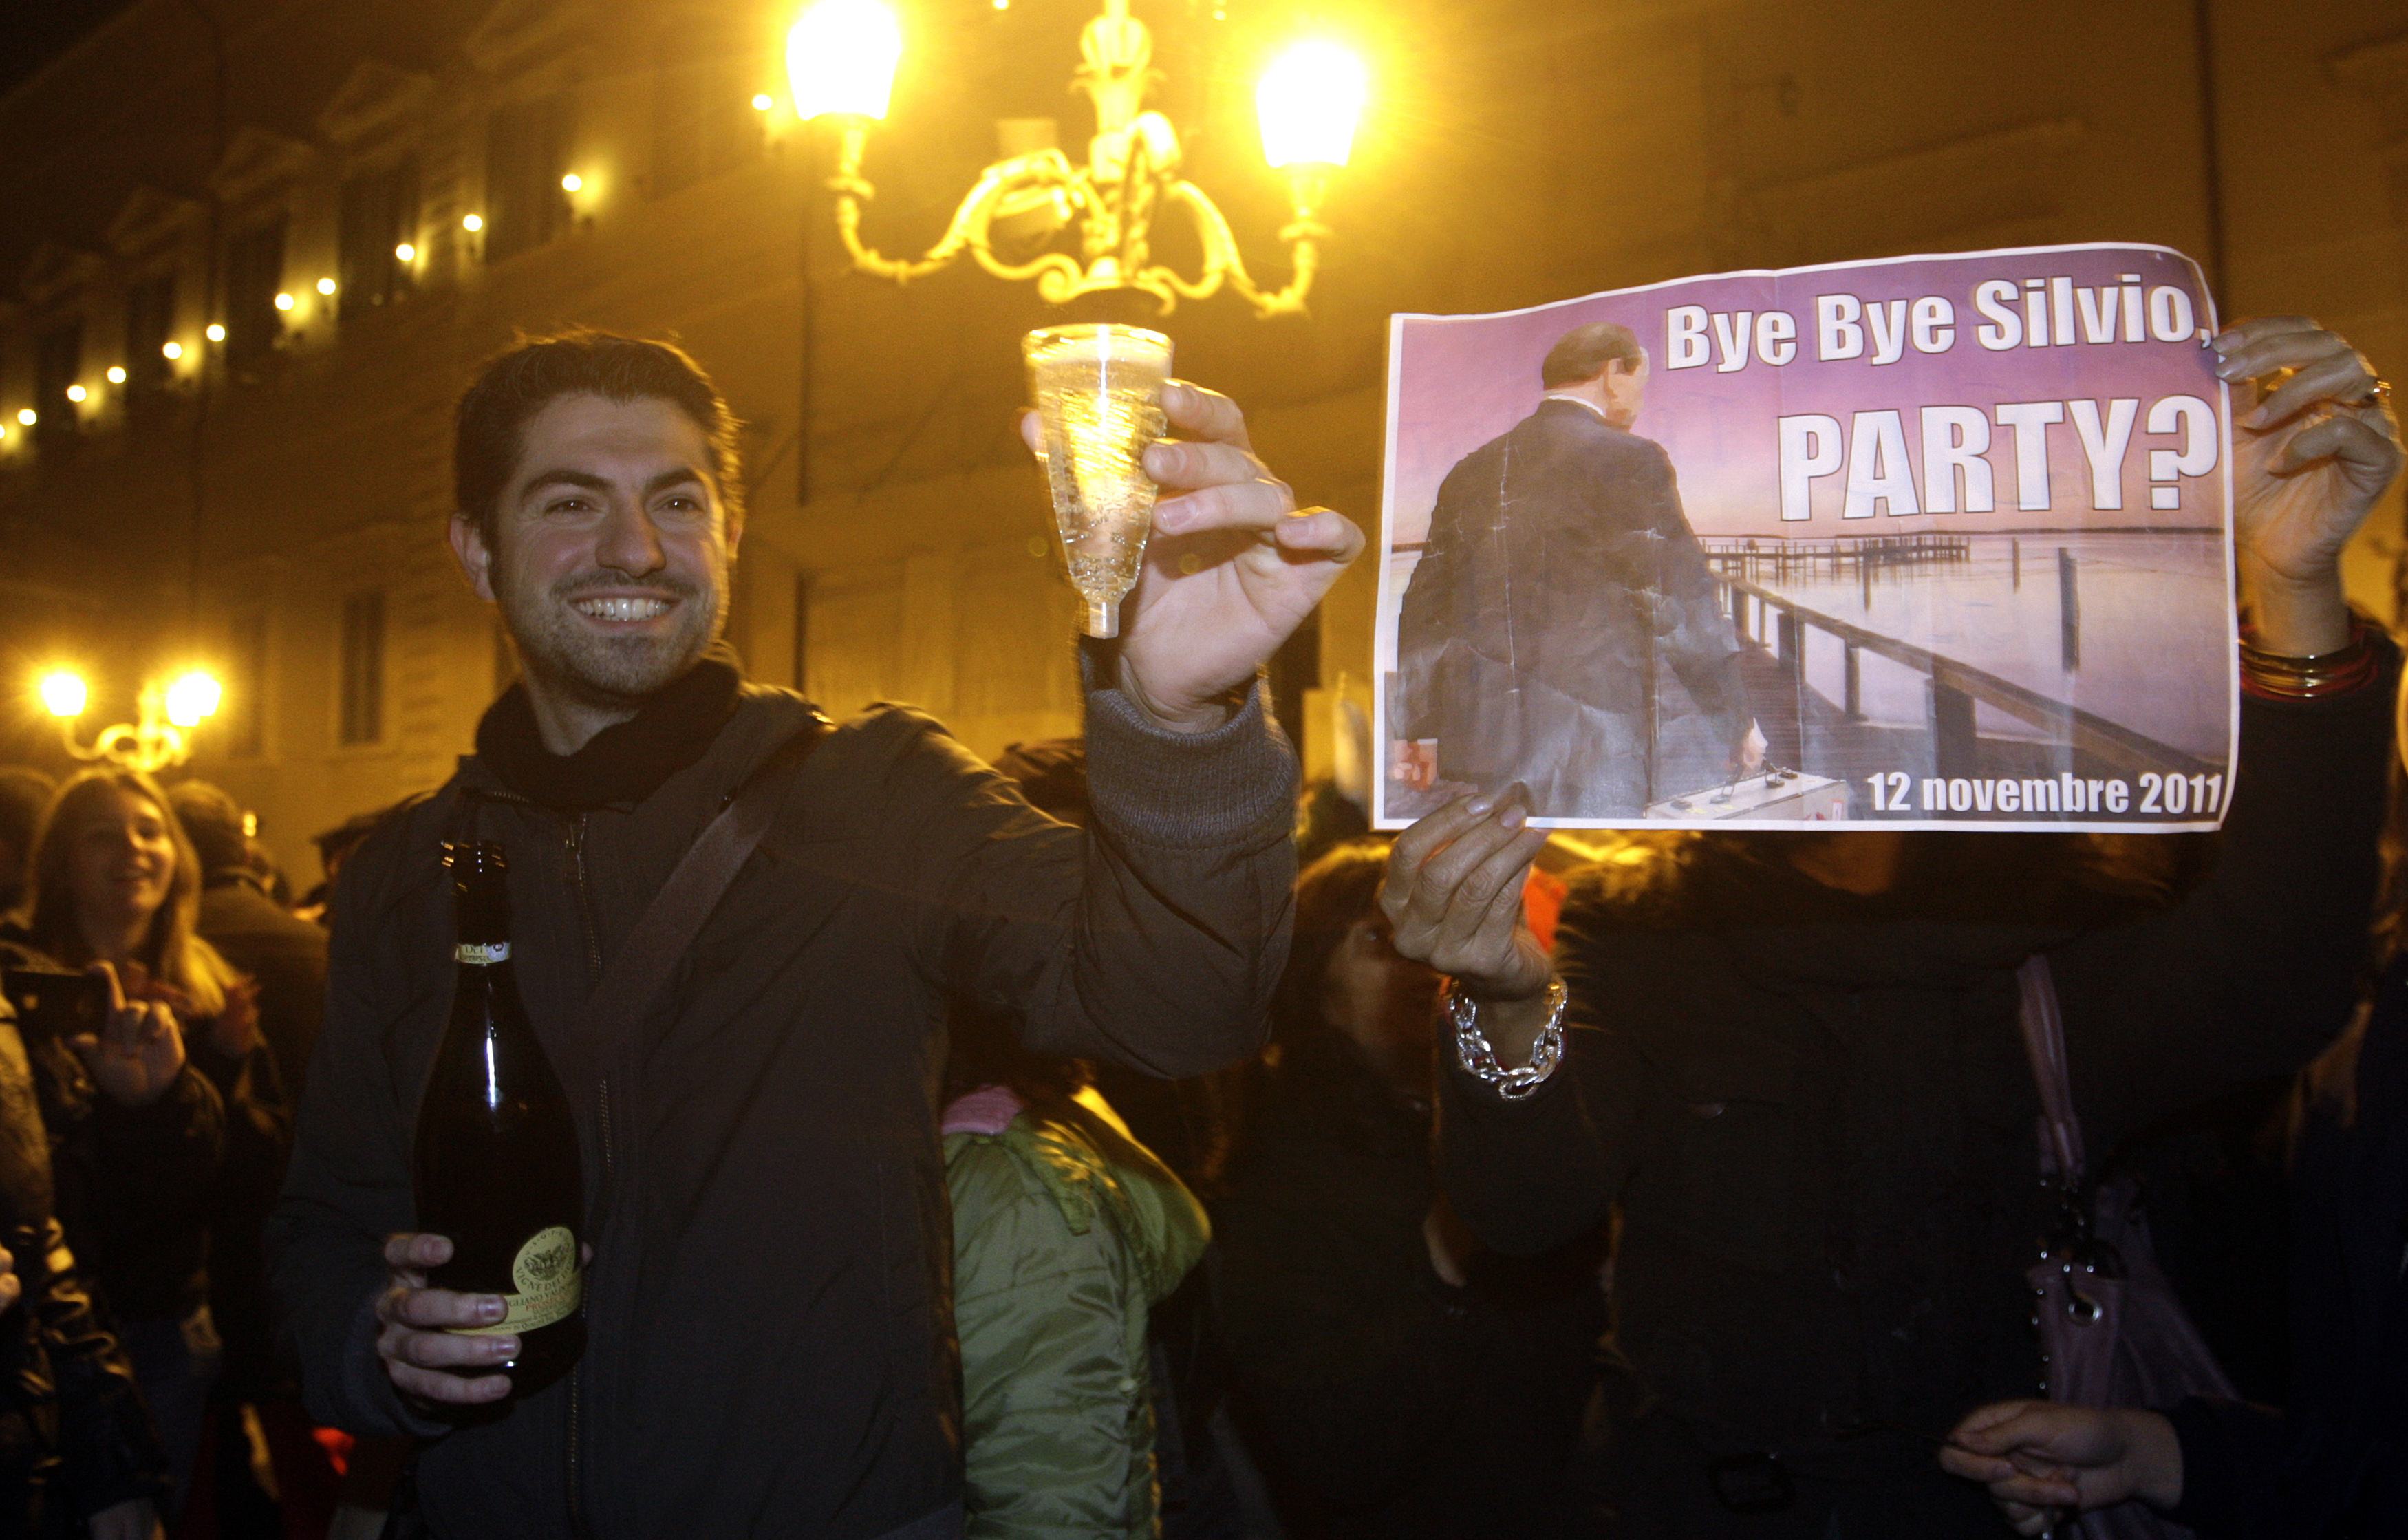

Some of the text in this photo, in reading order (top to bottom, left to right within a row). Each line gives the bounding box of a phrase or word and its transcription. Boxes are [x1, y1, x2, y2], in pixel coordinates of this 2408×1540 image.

[1666, 274, 2212, 373] Bye Bye Silvio,
[1778, 394, 2218, 521] PARTY?
[1868, 772, 2222, 814] 12 novembre 2011
